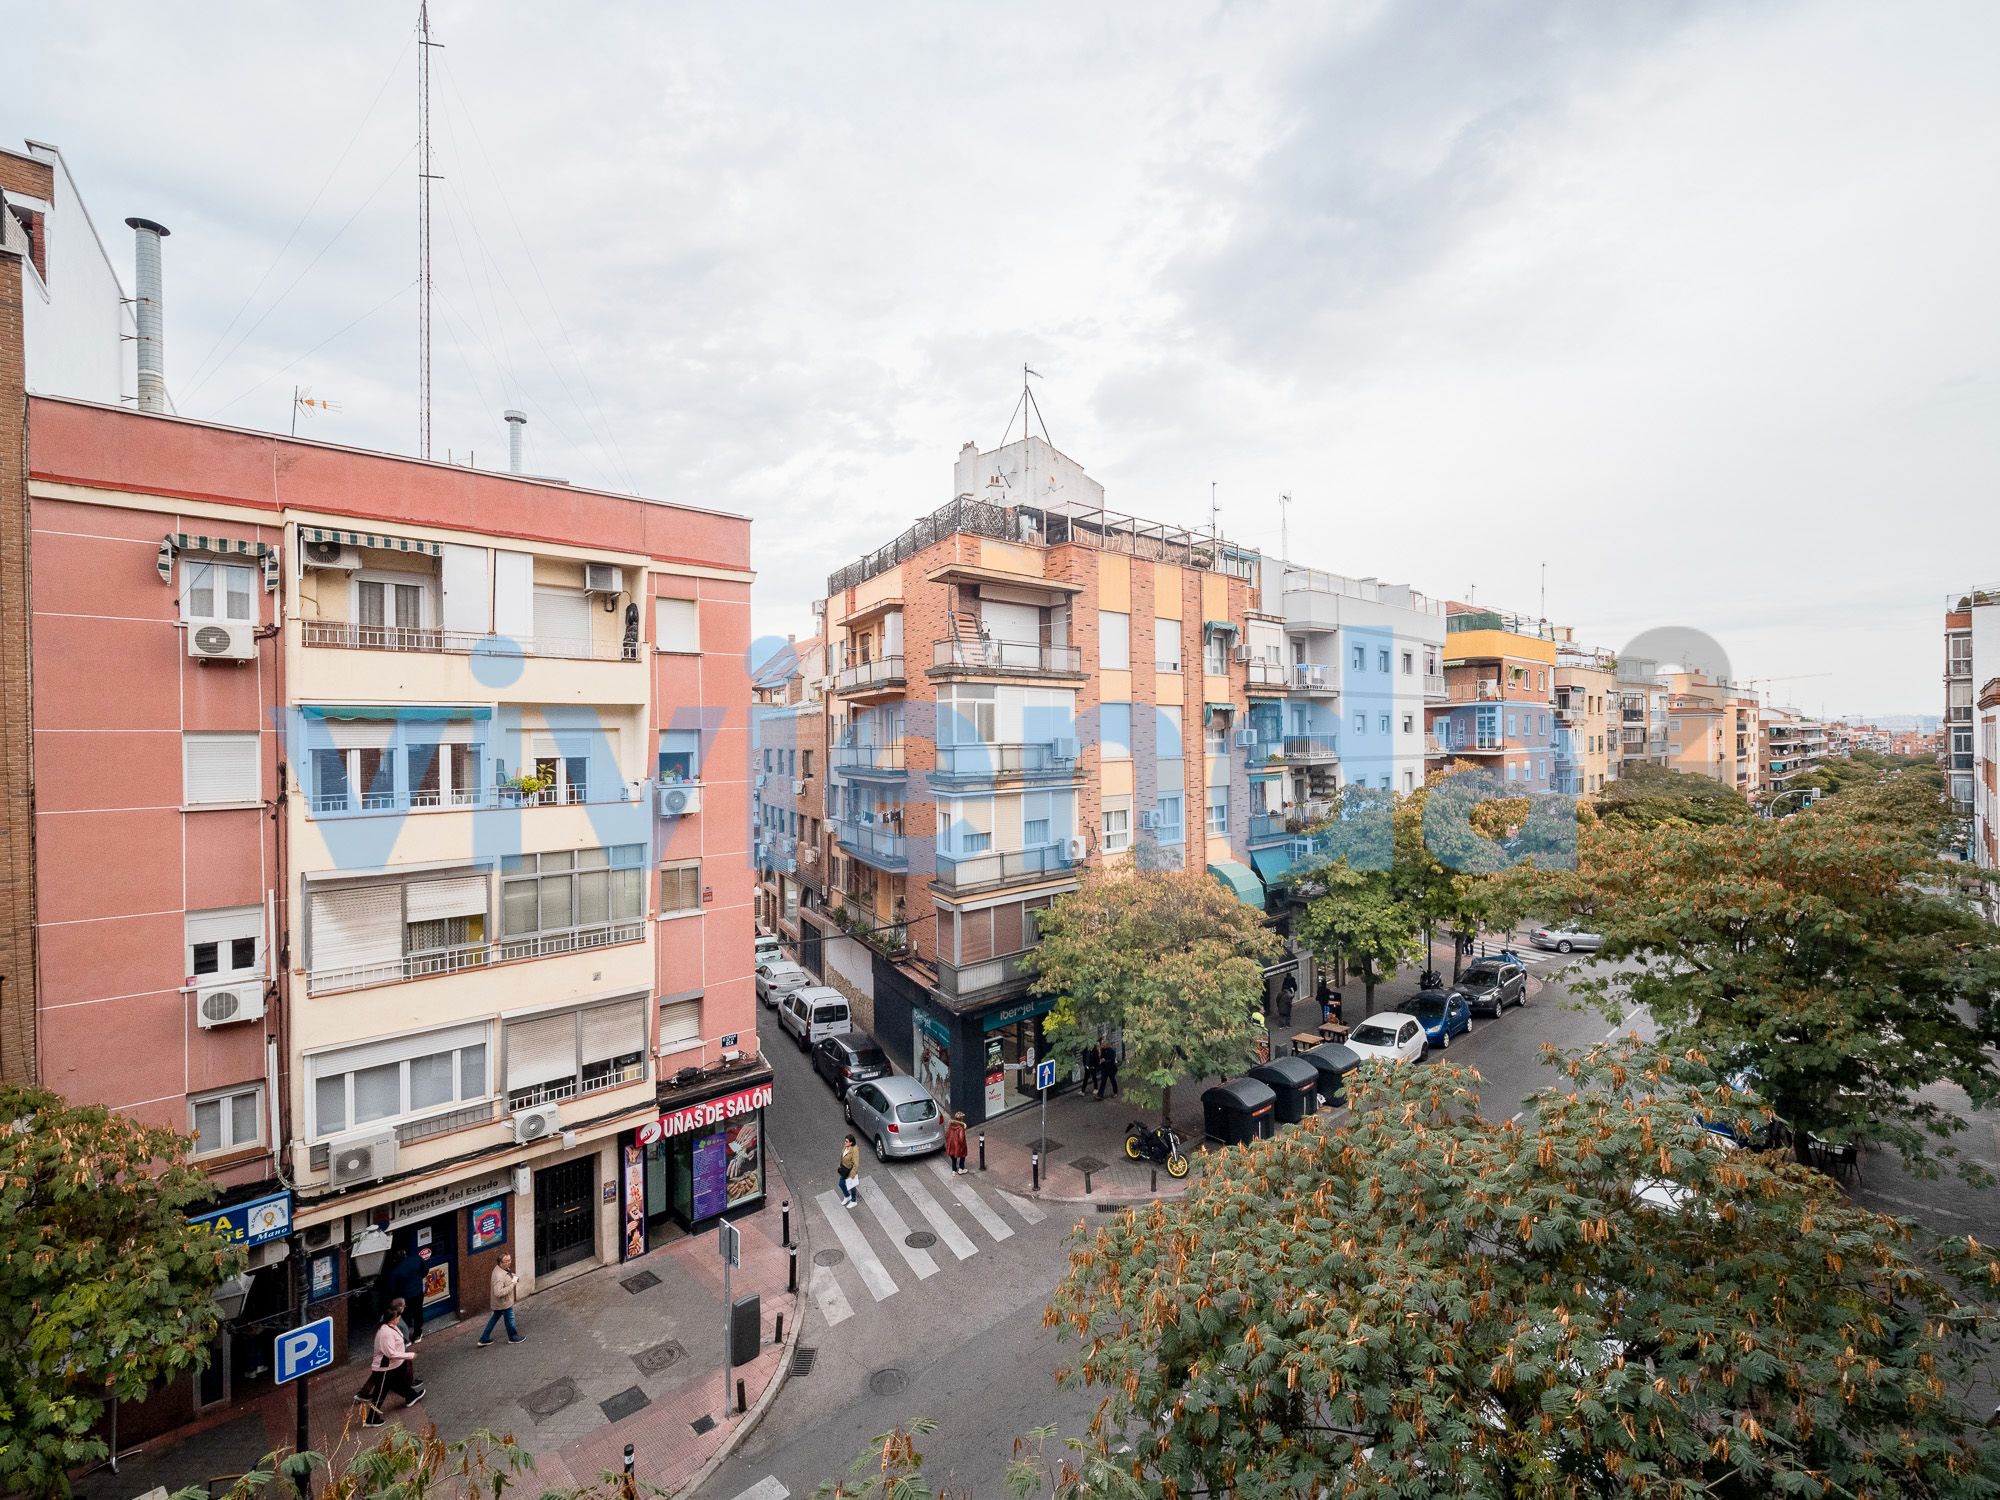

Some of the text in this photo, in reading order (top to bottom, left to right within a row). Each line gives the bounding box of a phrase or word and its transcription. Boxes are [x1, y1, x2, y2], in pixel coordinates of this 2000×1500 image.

[663, 1087, 772, 1137] UÑAS DE SALÓN
[399, 1197, 446, 1217] Apuestas
[448, 1190, 464, 1201] del
[466, 1180, 499, 1196] Estado
[256, 1227, 288, 1242] Mano
[285, 1332, 318, 1376] P
